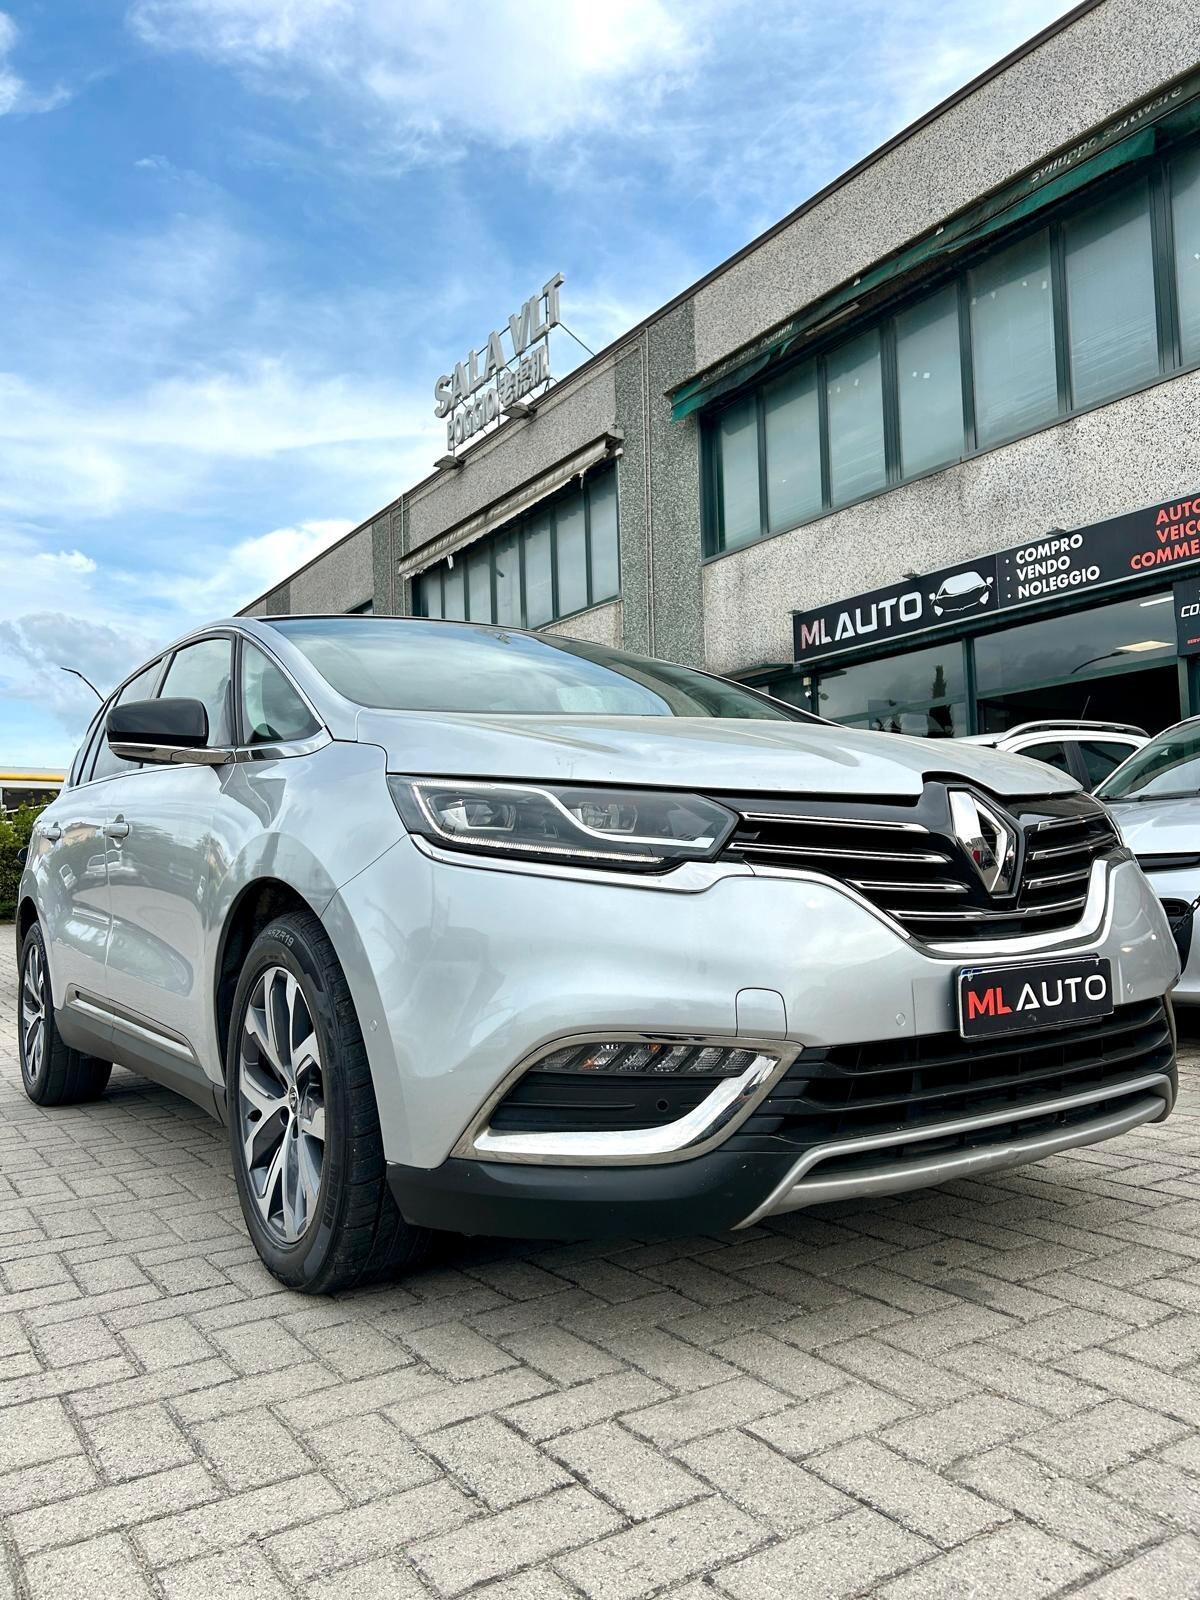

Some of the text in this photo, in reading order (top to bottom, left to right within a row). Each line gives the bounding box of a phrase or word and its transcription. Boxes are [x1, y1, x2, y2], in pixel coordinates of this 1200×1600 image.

[434, 272, 566, 418] SALA VLT
[447, 388, 500, 453] POGGIO
[1016, 534, 1083, 564] COMPRO
[1016, 555, 1071, 582] VENDO
[1018, 565, 1100, 599] NOLEGGIO
[967, 974, 1107, 1020] ML AUTO
